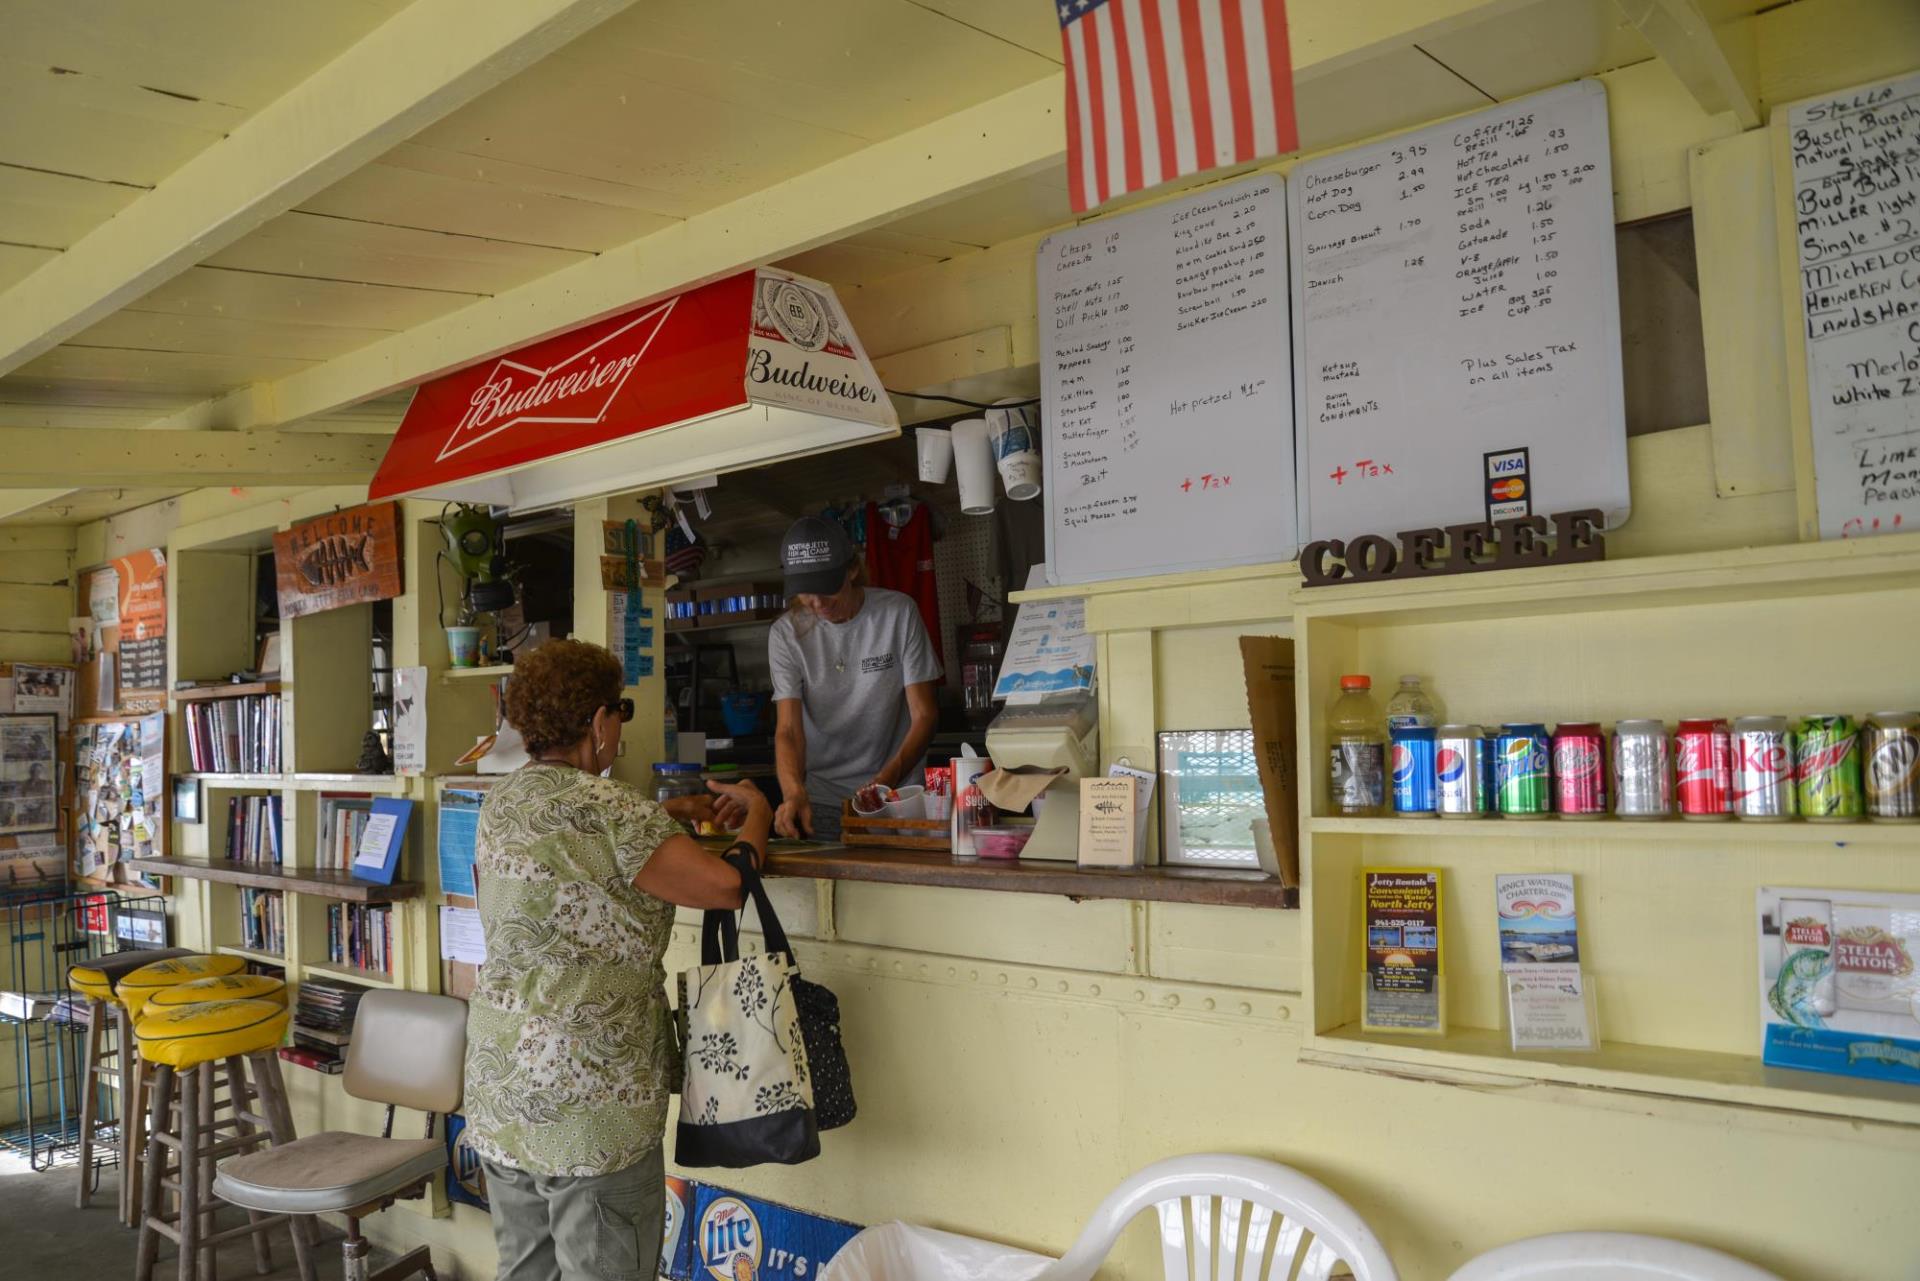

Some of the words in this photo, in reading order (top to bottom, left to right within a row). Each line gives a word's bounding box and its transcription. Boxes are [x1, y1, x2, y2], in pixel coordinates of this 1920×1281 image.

[1305, 164, 1381, 189] Cheeseburger
[1331, 186, 1353, 199] Dog
[1505, 351, 1543, 364] Sales
[1546, 341, 1577, 355] Tax
[747, 346, 878, 405] Budweiser
[467, 354, 638, 429] Budweiser
[1356, 459, 1394, 479] Tax
[1493, 459, 1525, 473] VISA
[1300, 509, 1605, 588] COFFEE
[1791, 926, 1823, 937] STELLA
[1838, 943, 1895, 958] STELLA
[1838, 956, 1897, 970] ARTOIS
[768, 1247, 808, 1277] IT'S
